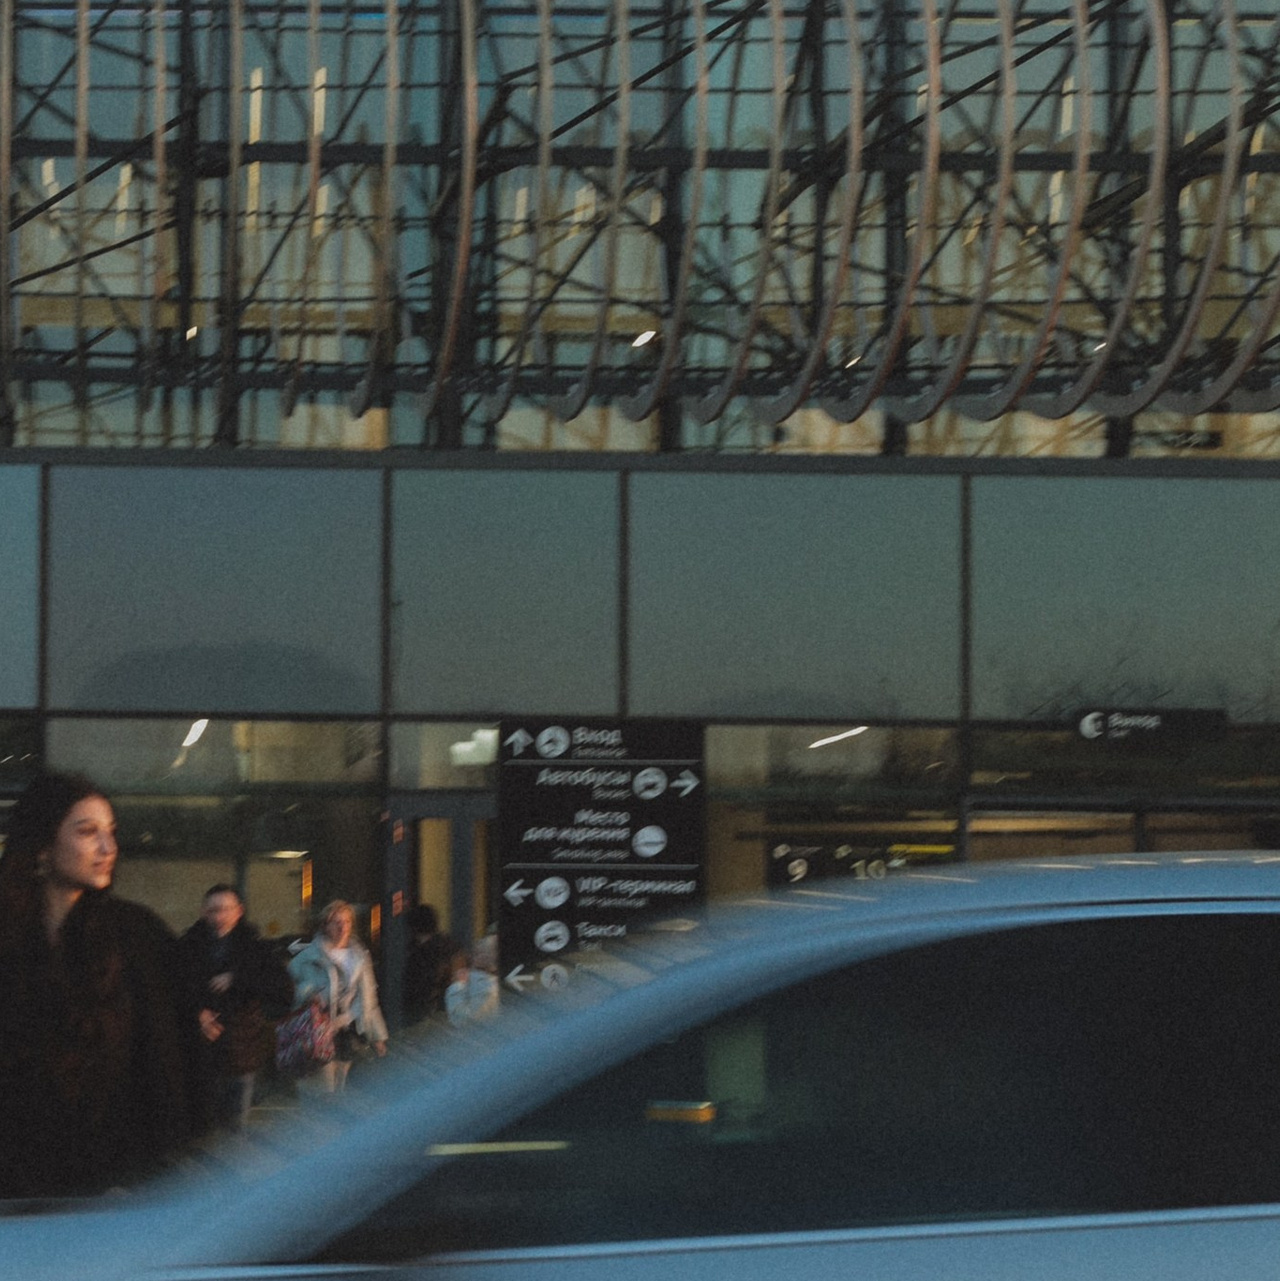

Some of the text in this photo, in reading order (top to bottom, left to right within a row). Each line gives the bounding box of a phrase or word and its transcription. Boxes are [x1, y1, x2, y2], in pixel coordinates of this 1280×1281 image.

[572, 726, 623, 746] Вход
[536, 768, 631, 788] Автобусы
[574, 809, 631, 824] Место
[523, 827, 630, 843] для курения
[575, 876, 697, 897] VIP-терминал
[576, 921, 627, 938] Такси
